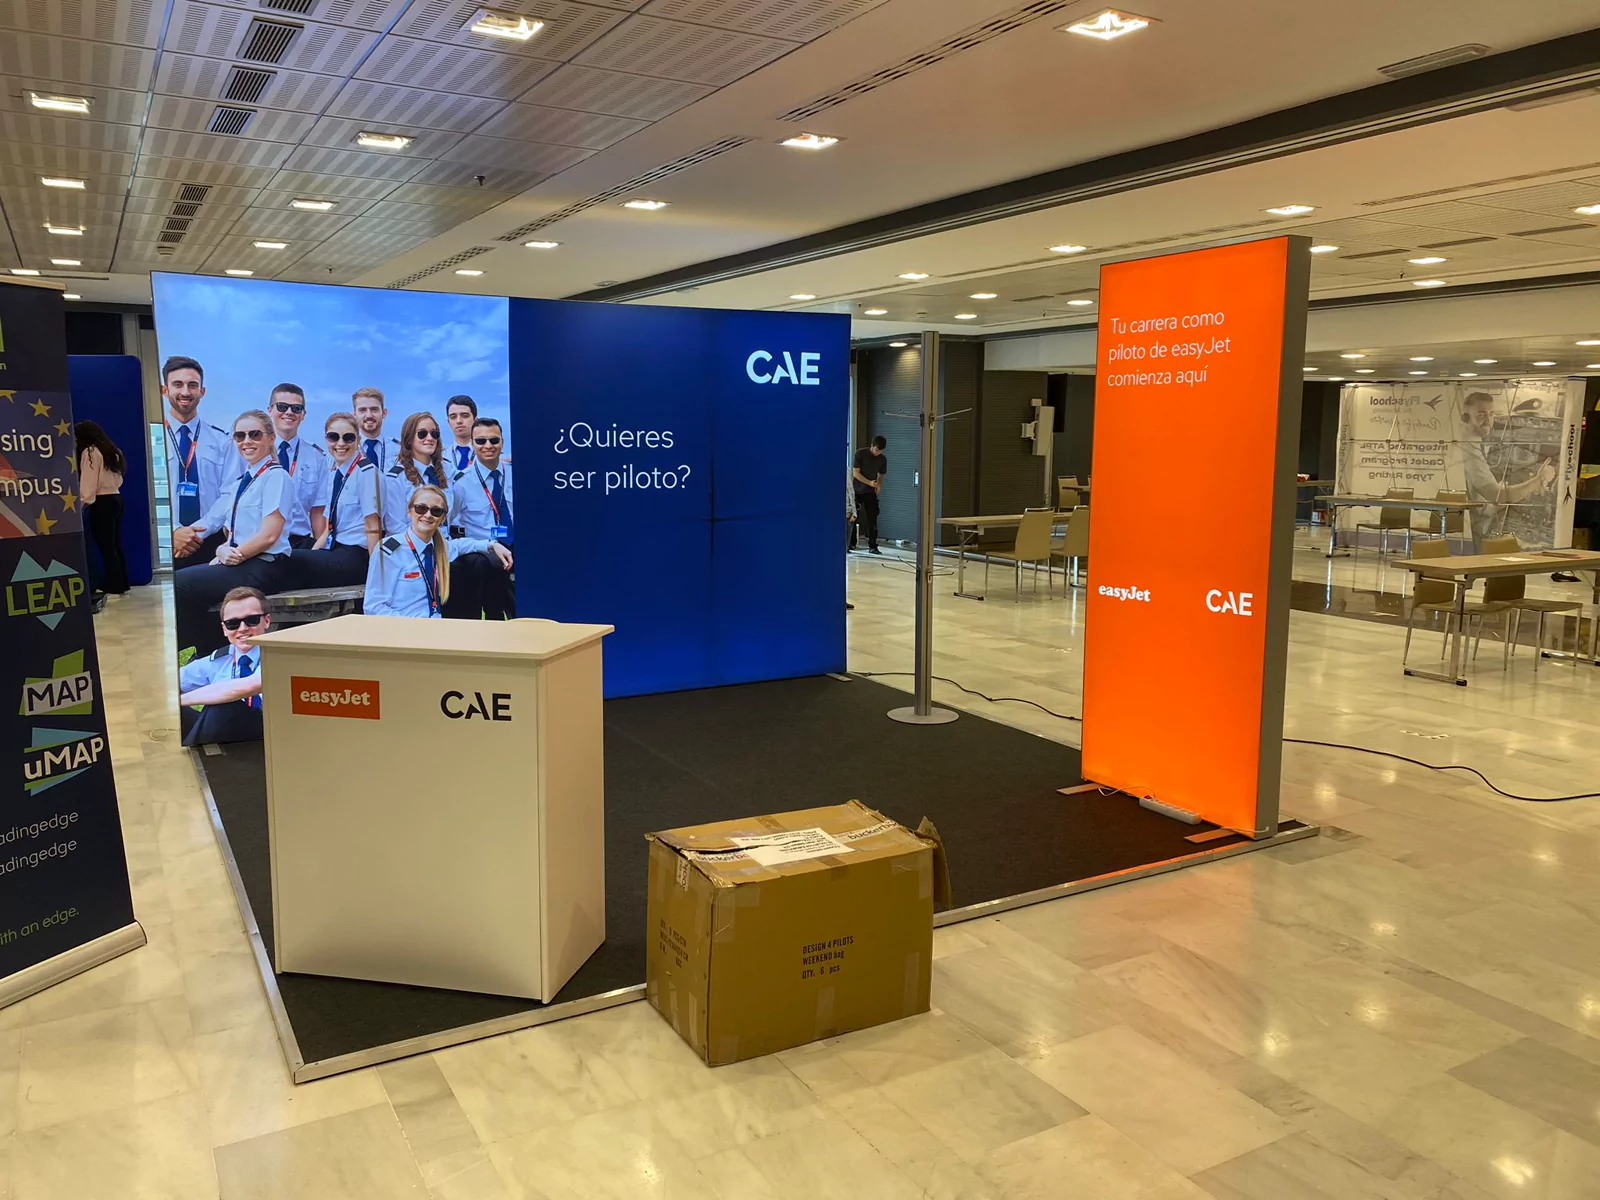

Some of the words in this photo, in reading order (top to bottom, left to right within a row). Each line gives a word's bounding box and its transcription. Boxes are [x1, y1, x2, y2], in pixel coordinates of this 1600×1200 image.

[1110, 318, 1126, 334] Tu
[1130, 316, 1177, 333] carrera
[1181, 312, 1225, 329] como
[1108, 343, 1146, 364] piloto
[1149, 340, 1167, 358] de
[1171, 336, 1231, 359] easyJet
[746, 350, 821, 385] CAE
[1107, 369, 1172, 387] comienza
[1176, 365, 1208, 387] aquí
[554, 422, 674, 454] ¿Quieres
[554, 471, 596, 490] ser
[605, 463, 691, 495] piloto?
[6, 577, 85, 617] LEAP
[1098, 585, 1151, 602] easyJet
[1205, 589, 1253, 616] CAE
[27, 675, 89, 712] MAP
[300, 689, 371, 707] easyJet
[440, 690, 512, 721] CAE
[24, 736, 105, 780] uMAP
[20, 922, 40, 937] an
[42, 907, 80, 928] edge.
[802, 941, 827, 955] DESIGN
[827, 940, 832, 949] 4
[833, 935, 854, 949] PILOTS
[802, 951, 833, 967] WEEKEND
[820, 966, 825, 975] 6
[829, 964, 841, 976] pcs
